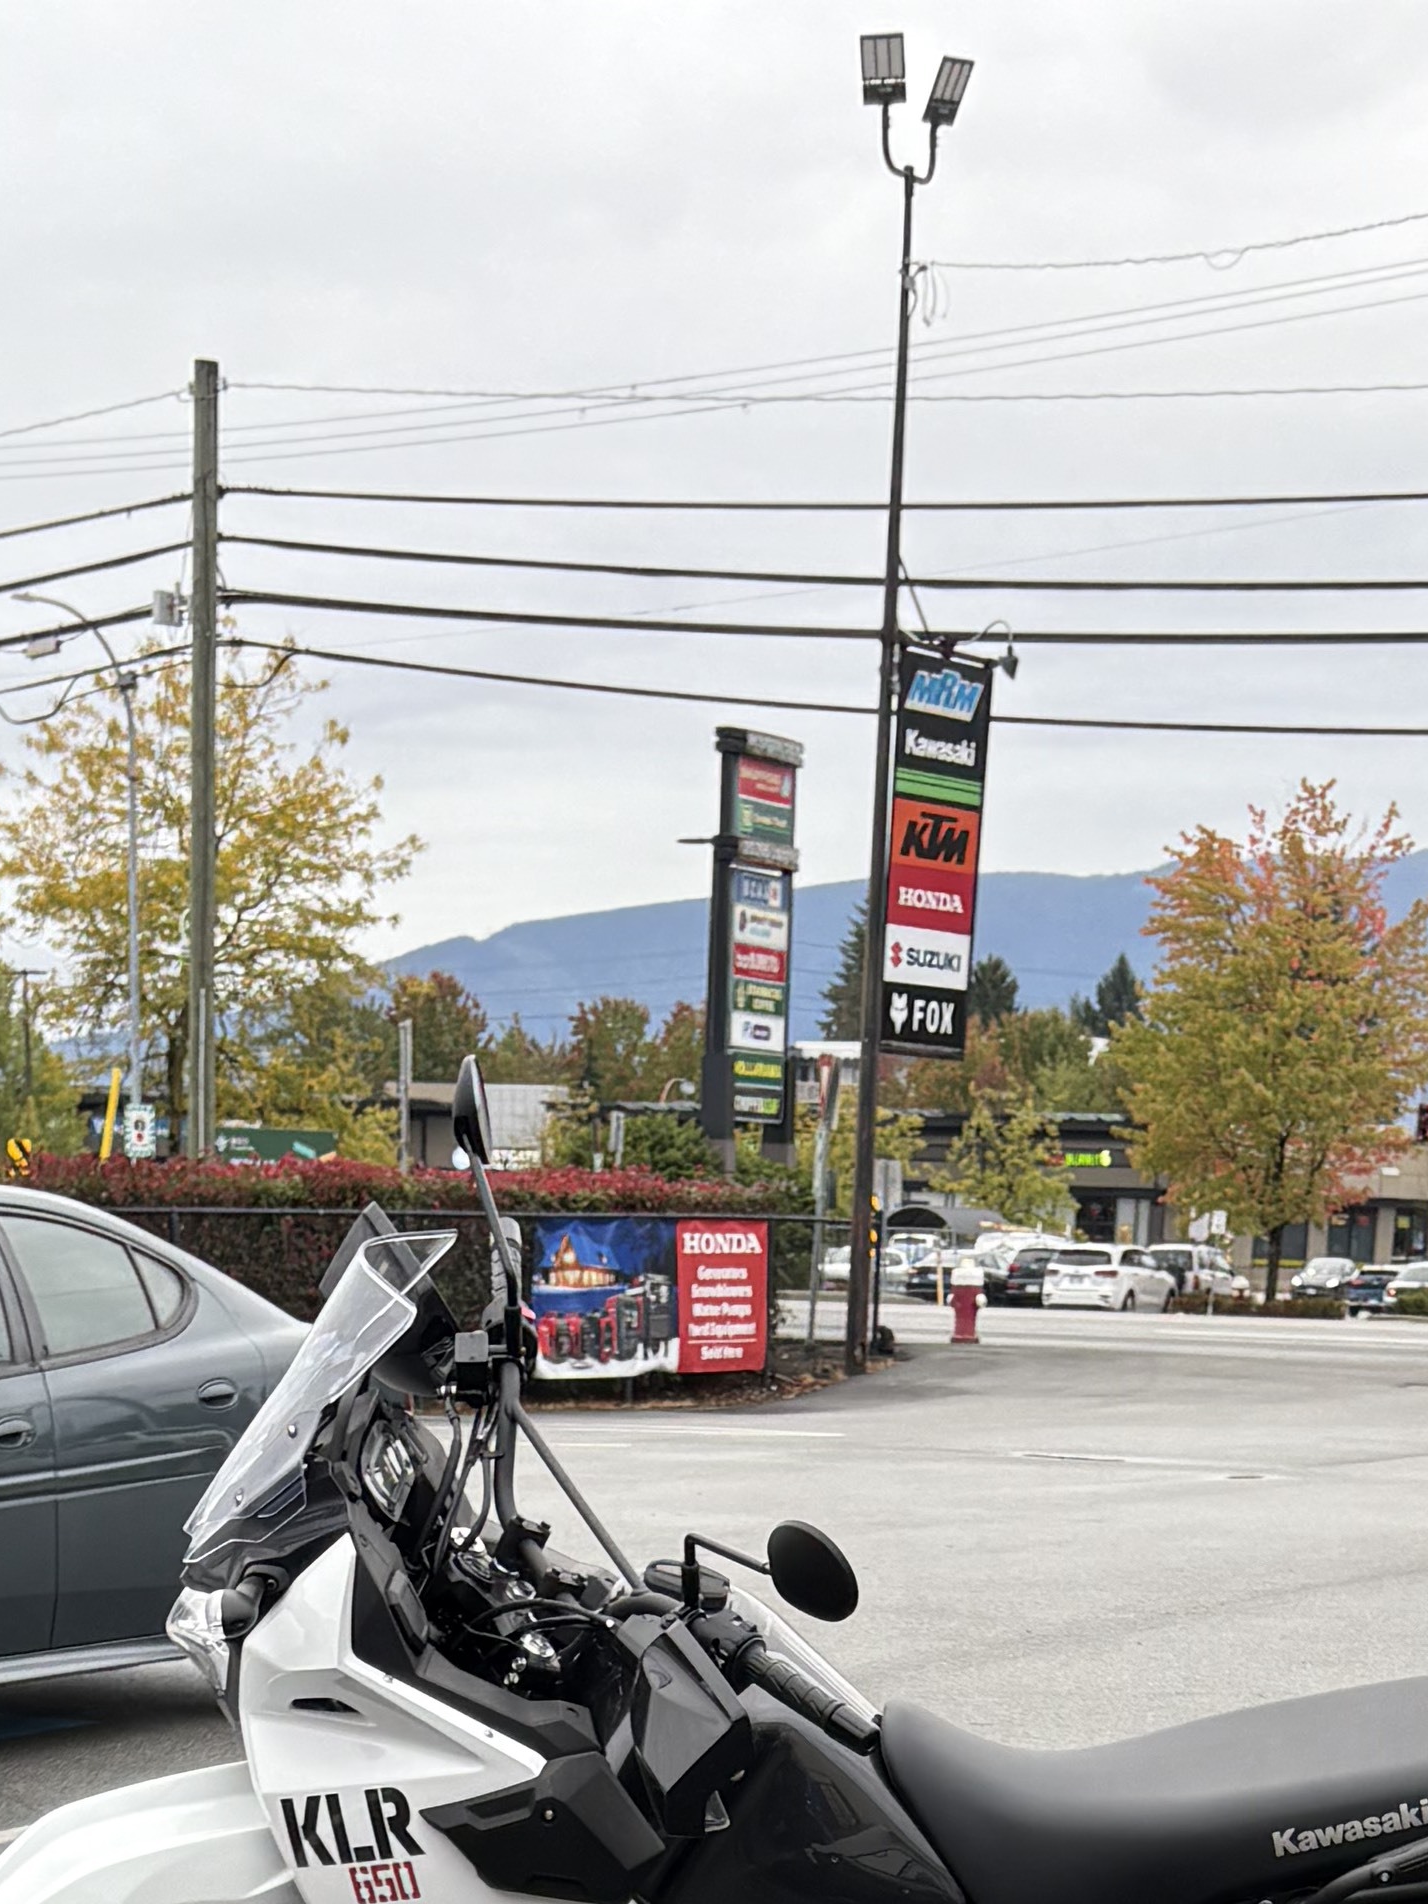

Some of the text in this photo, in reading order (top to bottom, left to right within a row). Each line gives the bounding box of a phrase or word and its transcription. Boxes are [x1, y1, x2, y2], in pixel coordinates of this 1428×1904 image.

[907, 670, 983, 717] MRM
[904, 727, 976, 767] Kawasaki
[901, 811, 970, 865] KTM
[898, 886, 964, 913] HONDA
[906, 947, 961, 973] SUZUKI
[912, 999, 955, 1035] FOX
[682, 1233, 762, 1254] HONDA
[280, 1787, 426, 1868] KLR
[348, 1861, 421, 1904] 650
